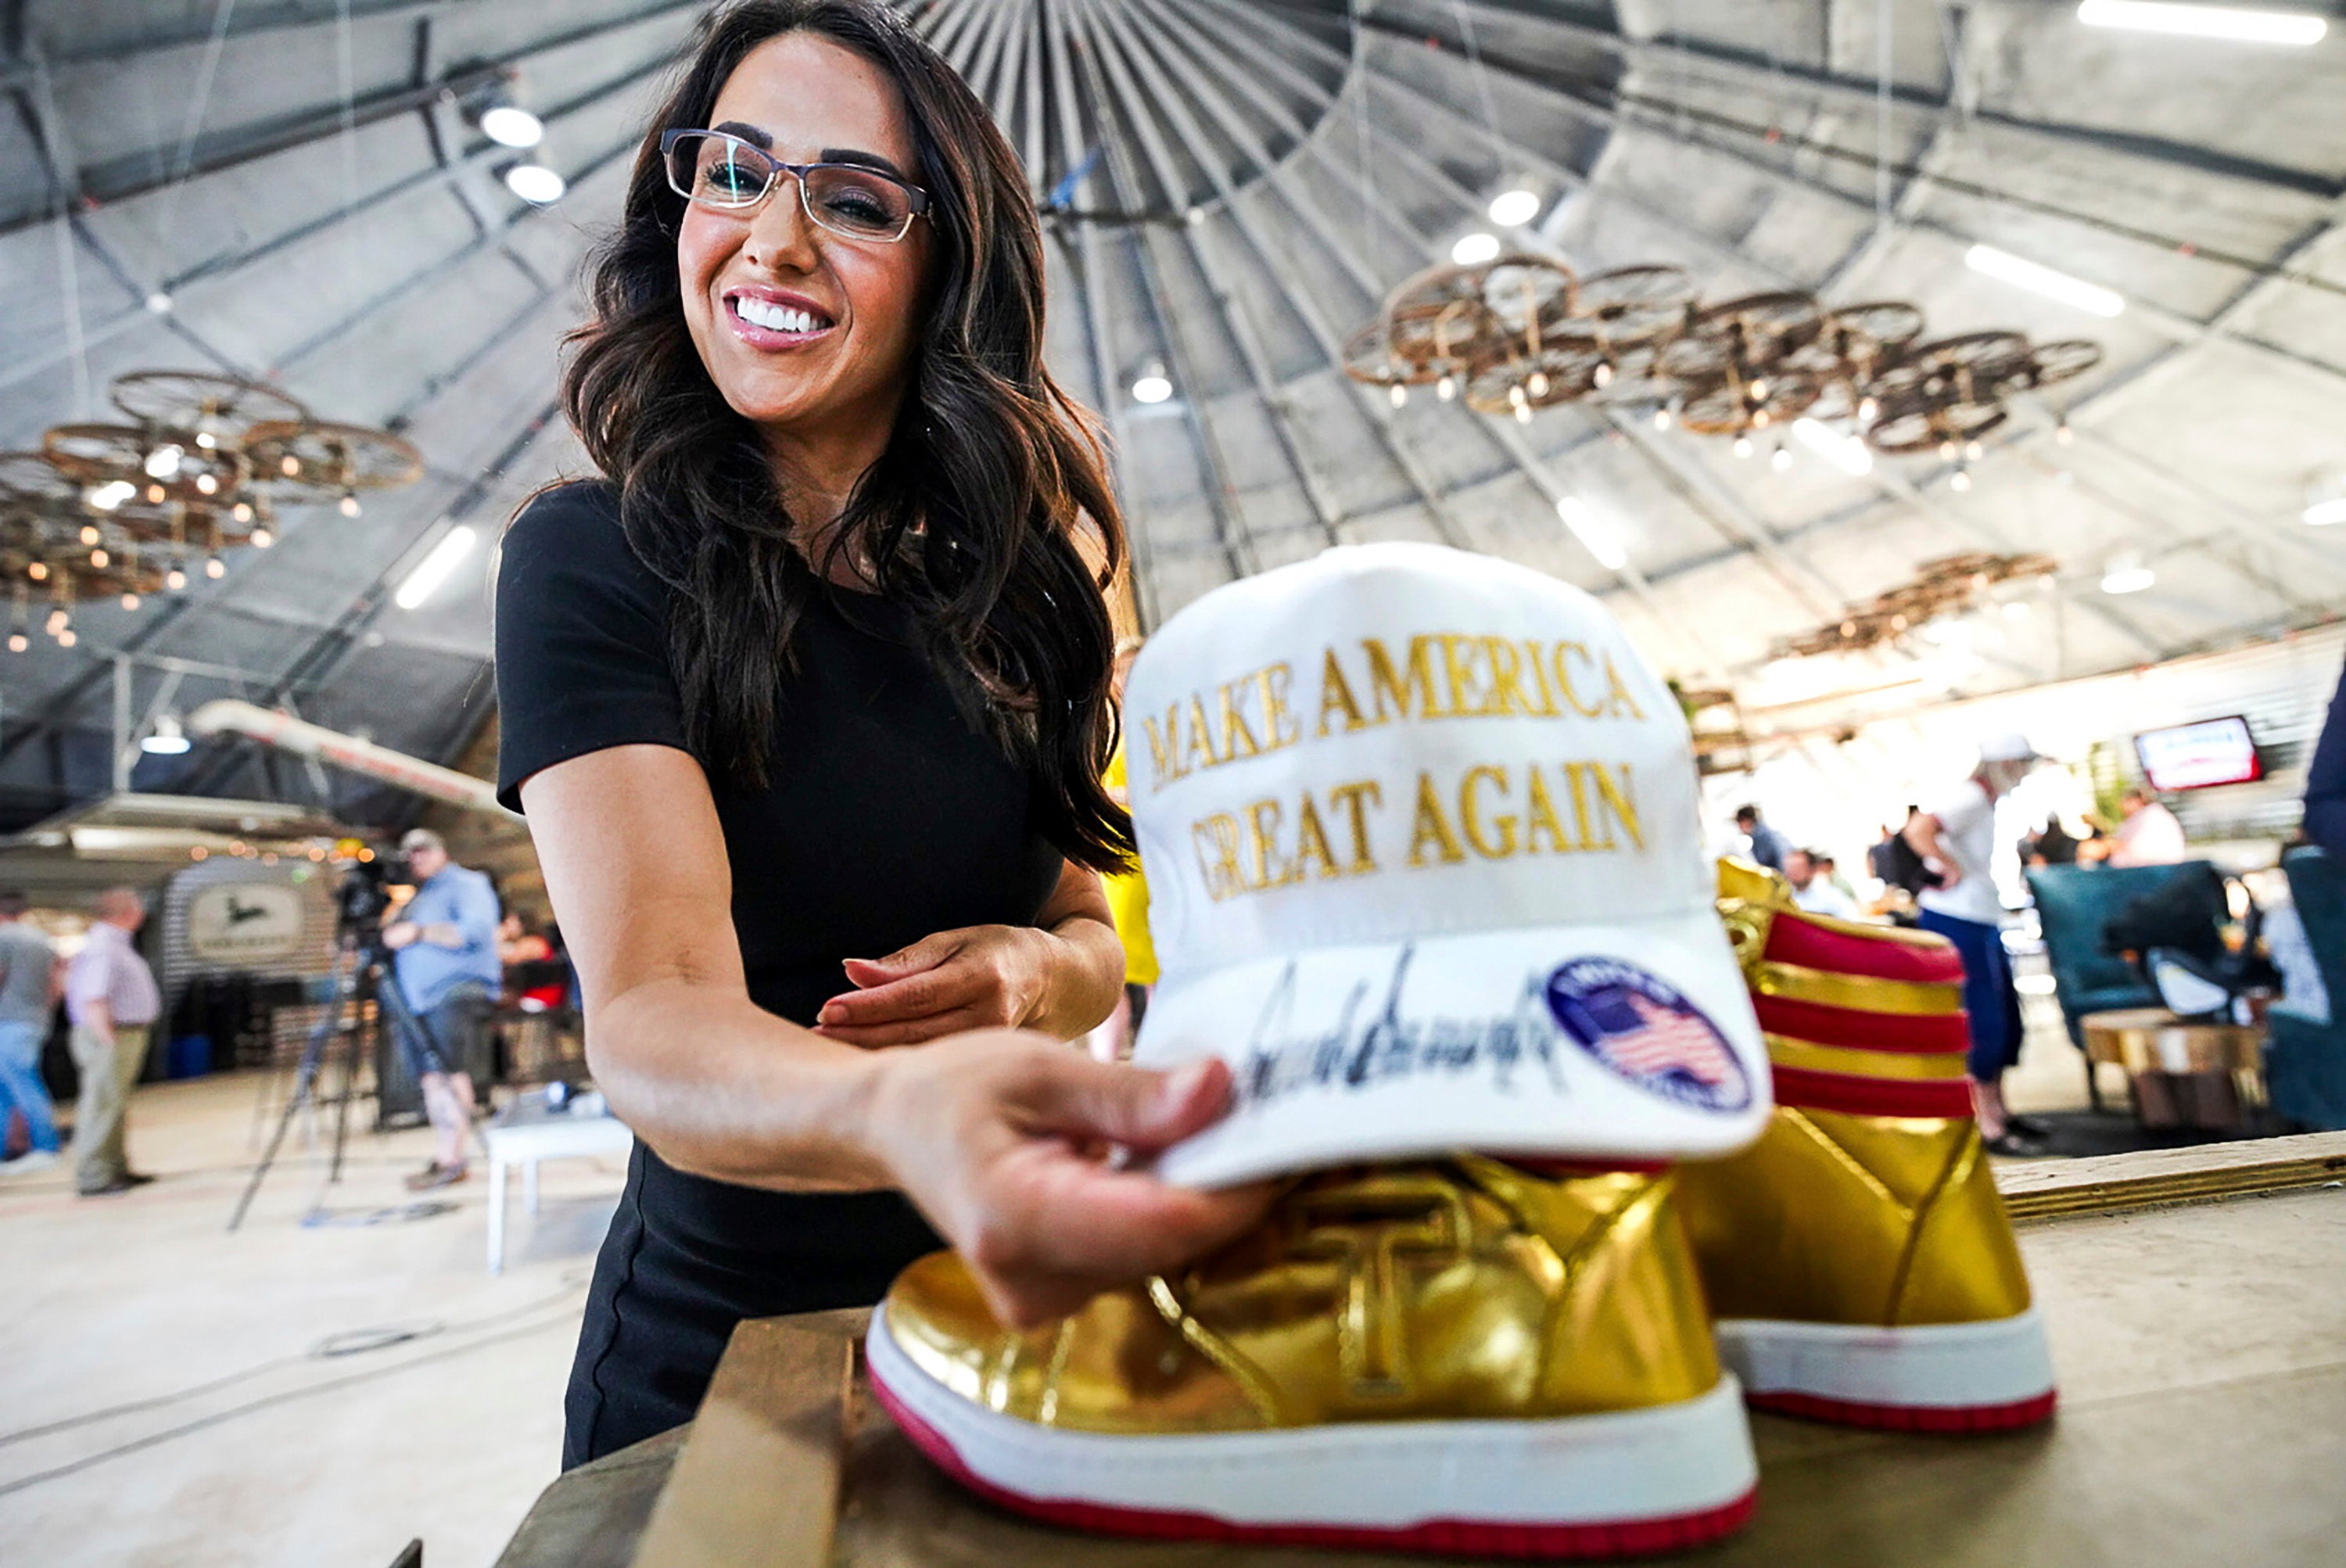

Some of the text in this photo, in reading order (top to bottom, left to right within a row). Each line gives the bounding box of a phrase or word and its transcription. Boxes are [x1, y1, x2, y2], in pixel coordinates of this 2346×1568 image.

[1143, 633, 1648, 793] MAKE AMERICA
[1192, 760, 1646, 903] GREAT AGAIN
